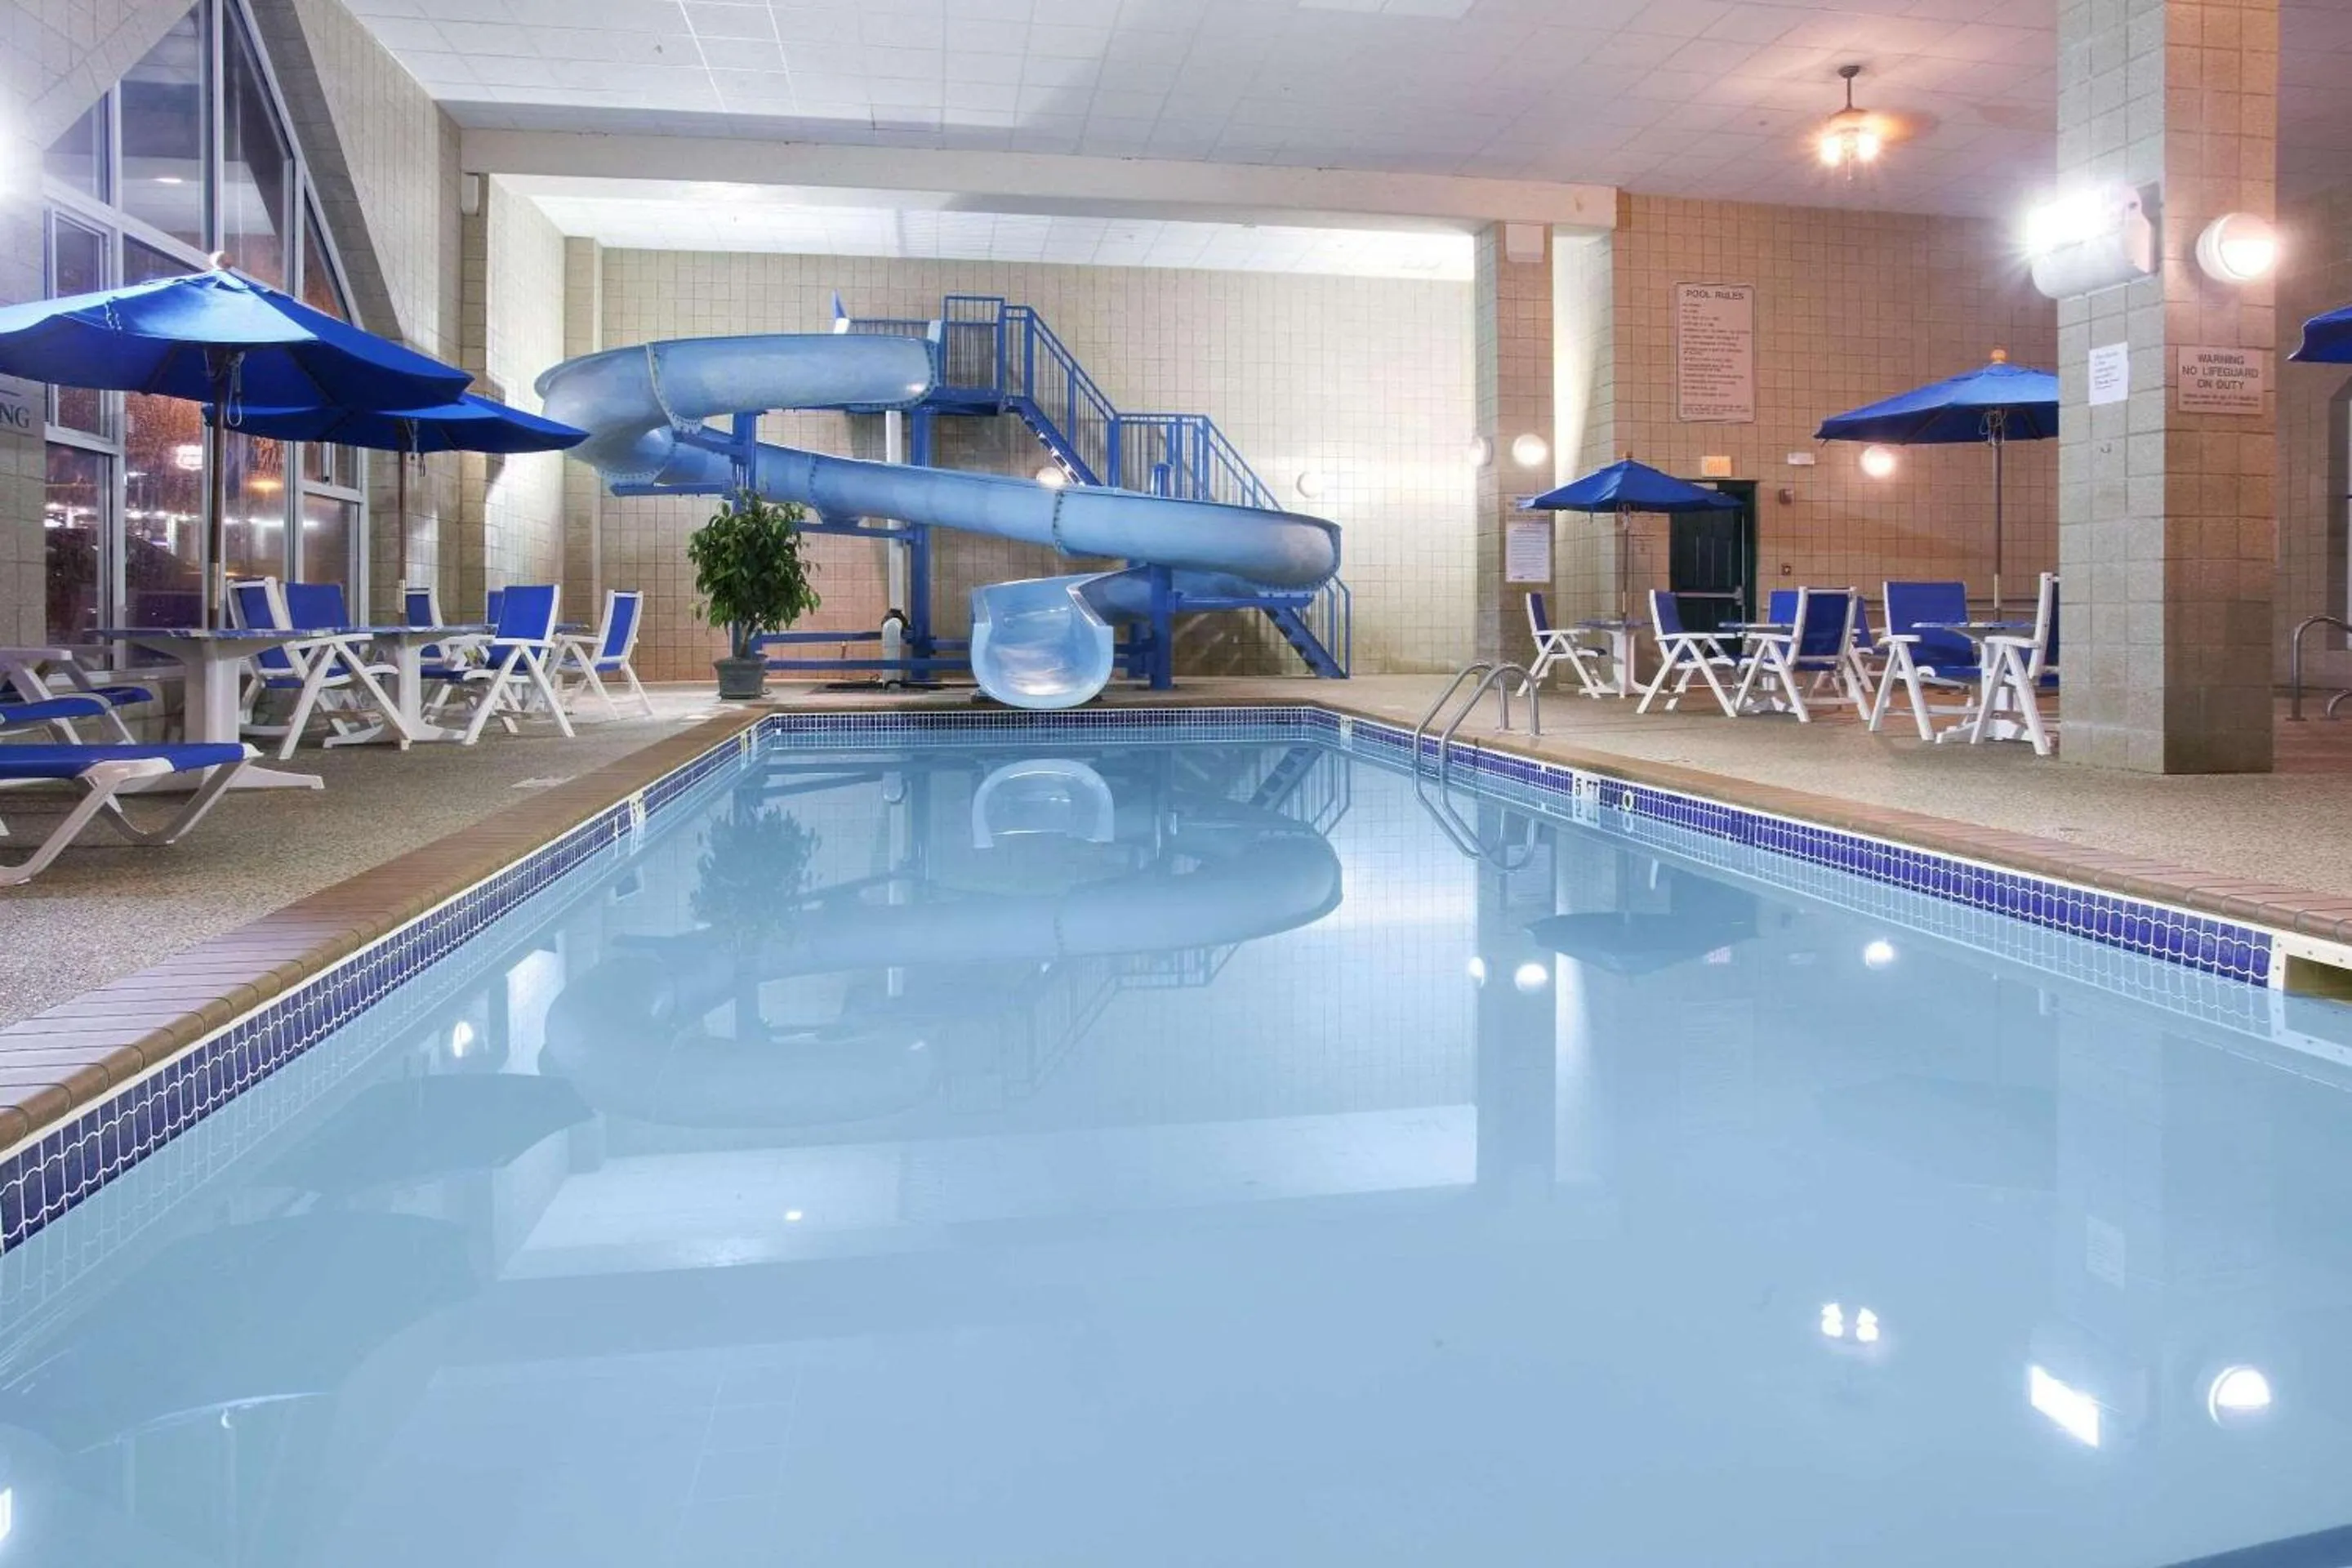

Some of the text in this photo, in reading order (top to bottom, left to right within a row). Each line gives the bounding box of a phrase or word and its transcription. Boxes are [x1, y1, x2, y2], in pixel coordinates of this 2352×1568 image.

[1686, 289, 1744, 301] POOL RULES
[2197, 354, 2244, 365] WARNING
[2182, 366, 2259, 378] NO LIFEGUARD
[2197, 379, 2245, 390] ON DUTY
